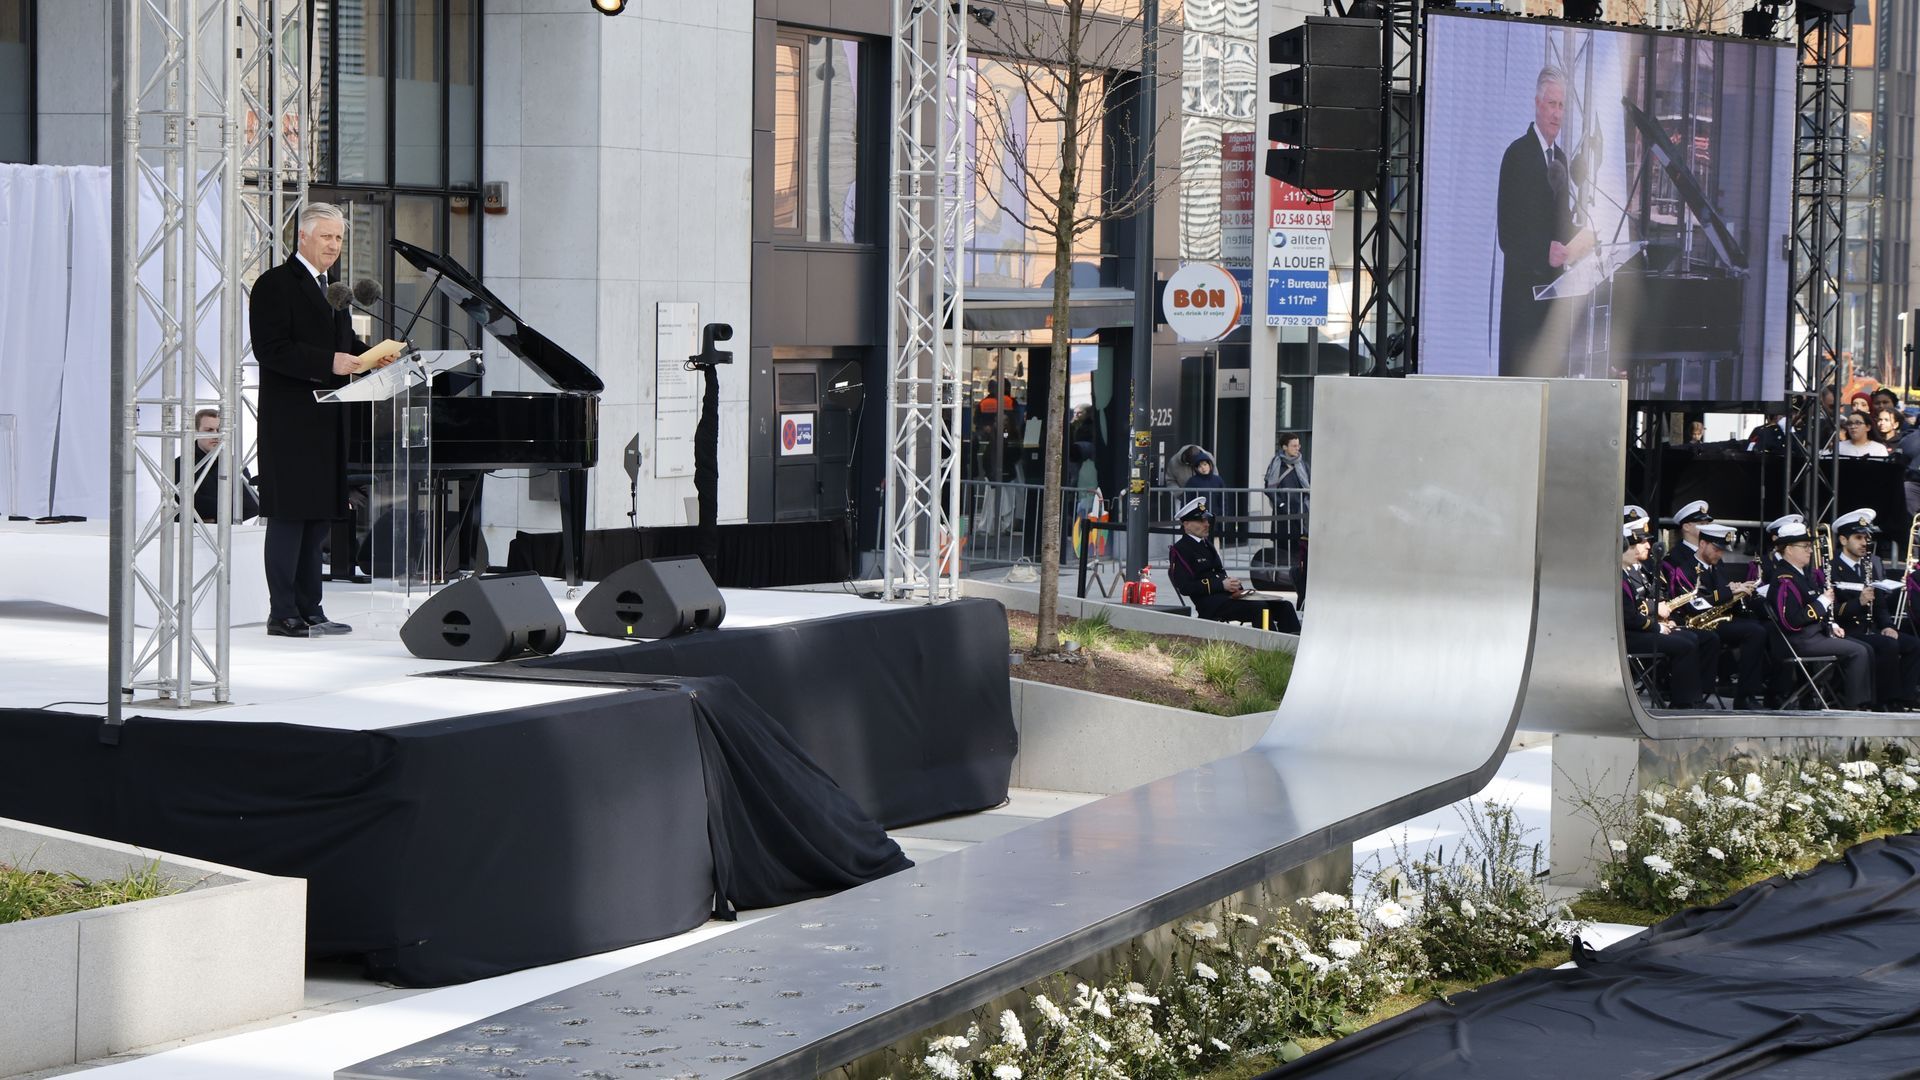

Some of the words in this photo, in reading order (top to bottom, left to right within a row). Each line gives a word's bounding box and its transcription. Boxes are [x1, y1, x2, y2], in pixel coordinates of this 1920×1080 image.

[1275, 213, 1286, 225] 02
[1289, 214, 1305, 225] 548
[1307, 214, 1313, 225] 0
[1315, 214, 1331, 225] 548
[1290, 235, 1325, 245] allten
[1272, 256, 1281, 268] A
[1284, 256, 1325, 269] LOUER
[1287, 278, 1327, 289] Bureaux
[1173, 288, 1225, 309] BON
[1287, 295, 1317, 305] 117m²
[1268, 316, 1278, 326] 02
[1282, 316, 1299, 326] 792
[1301, 316, 1313, 326] 92
[1315, 317, 1327, 326] 00
